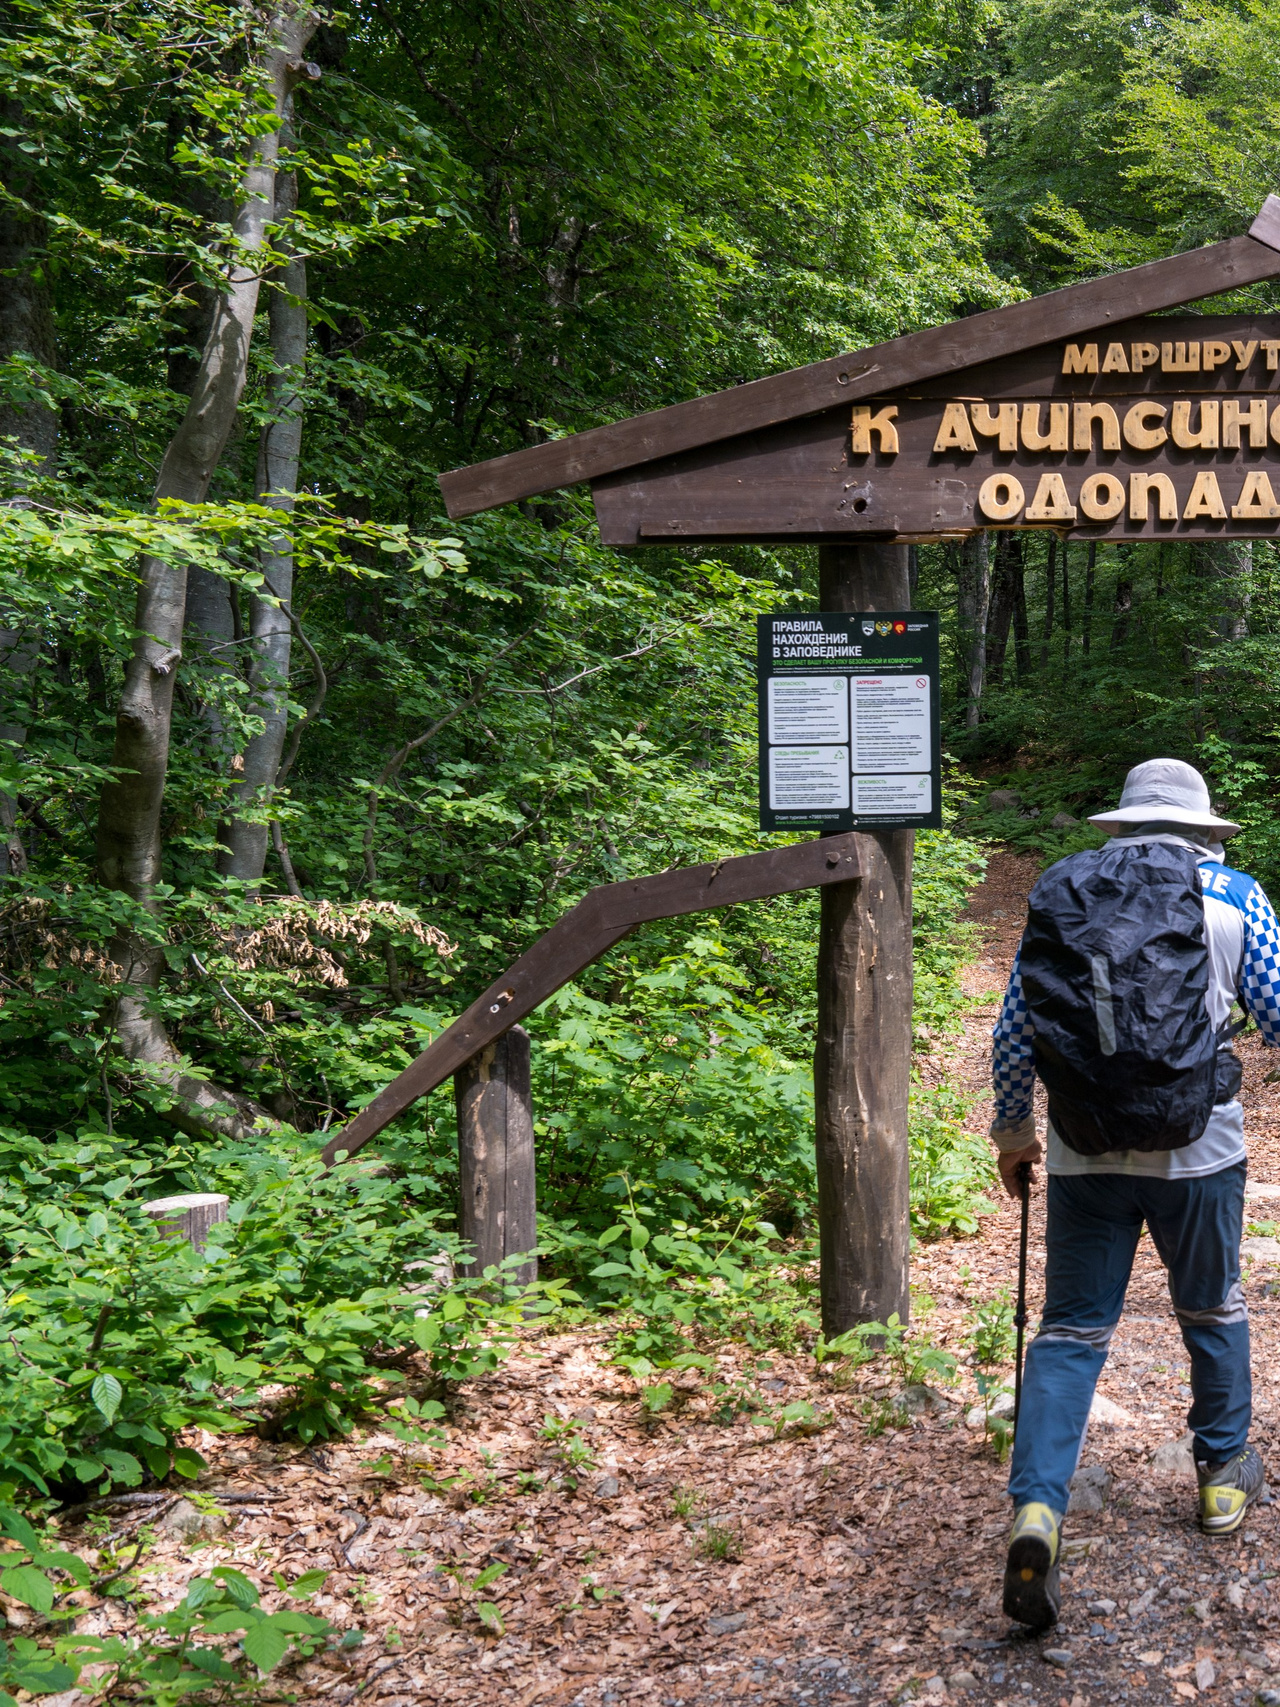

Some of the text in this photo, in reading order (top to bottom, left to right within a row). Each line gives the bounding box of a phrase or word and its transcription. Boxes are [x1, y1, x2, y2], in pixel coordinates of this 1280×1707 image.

[851, 405, 899, 454] К
[772, 620, 824, 632] ПРАВИЛА
[772, 633, 848, 646] НАХОЖДЕНИЯ
[773, 646, 862, 659] В ЗАПОВЕДНИКЕ
[1198, 867, 1232, 895] RE
